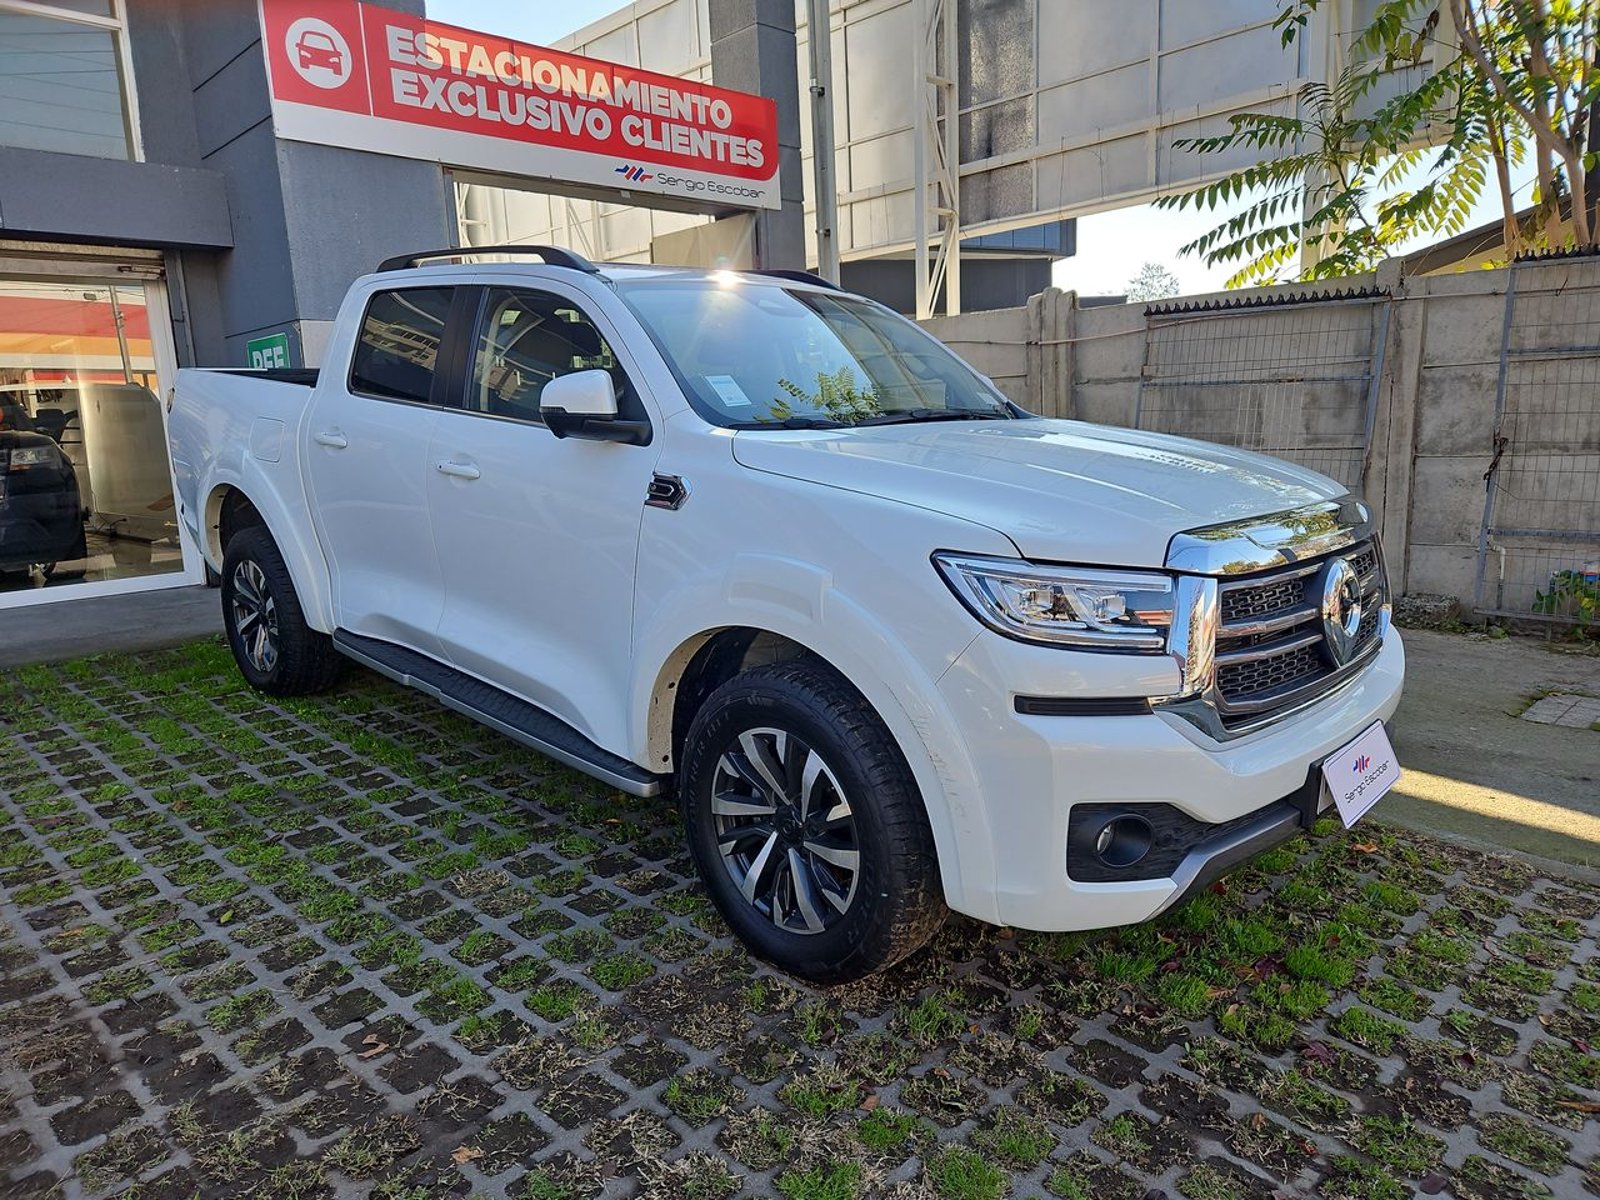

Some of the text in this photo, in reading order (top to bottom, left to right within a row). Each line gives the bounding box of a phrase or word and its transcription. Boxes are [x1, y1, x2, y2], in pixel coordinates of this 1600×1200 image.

[386, 25, 732, 129] ESTACIONAMIENTO
[390, 67, 765, 168] EXCLUSIVO CLIENTES
[657, 173, 766, 199] Sergio Escobar
[1344, 760, 1389, 804] Sergio Escobar
